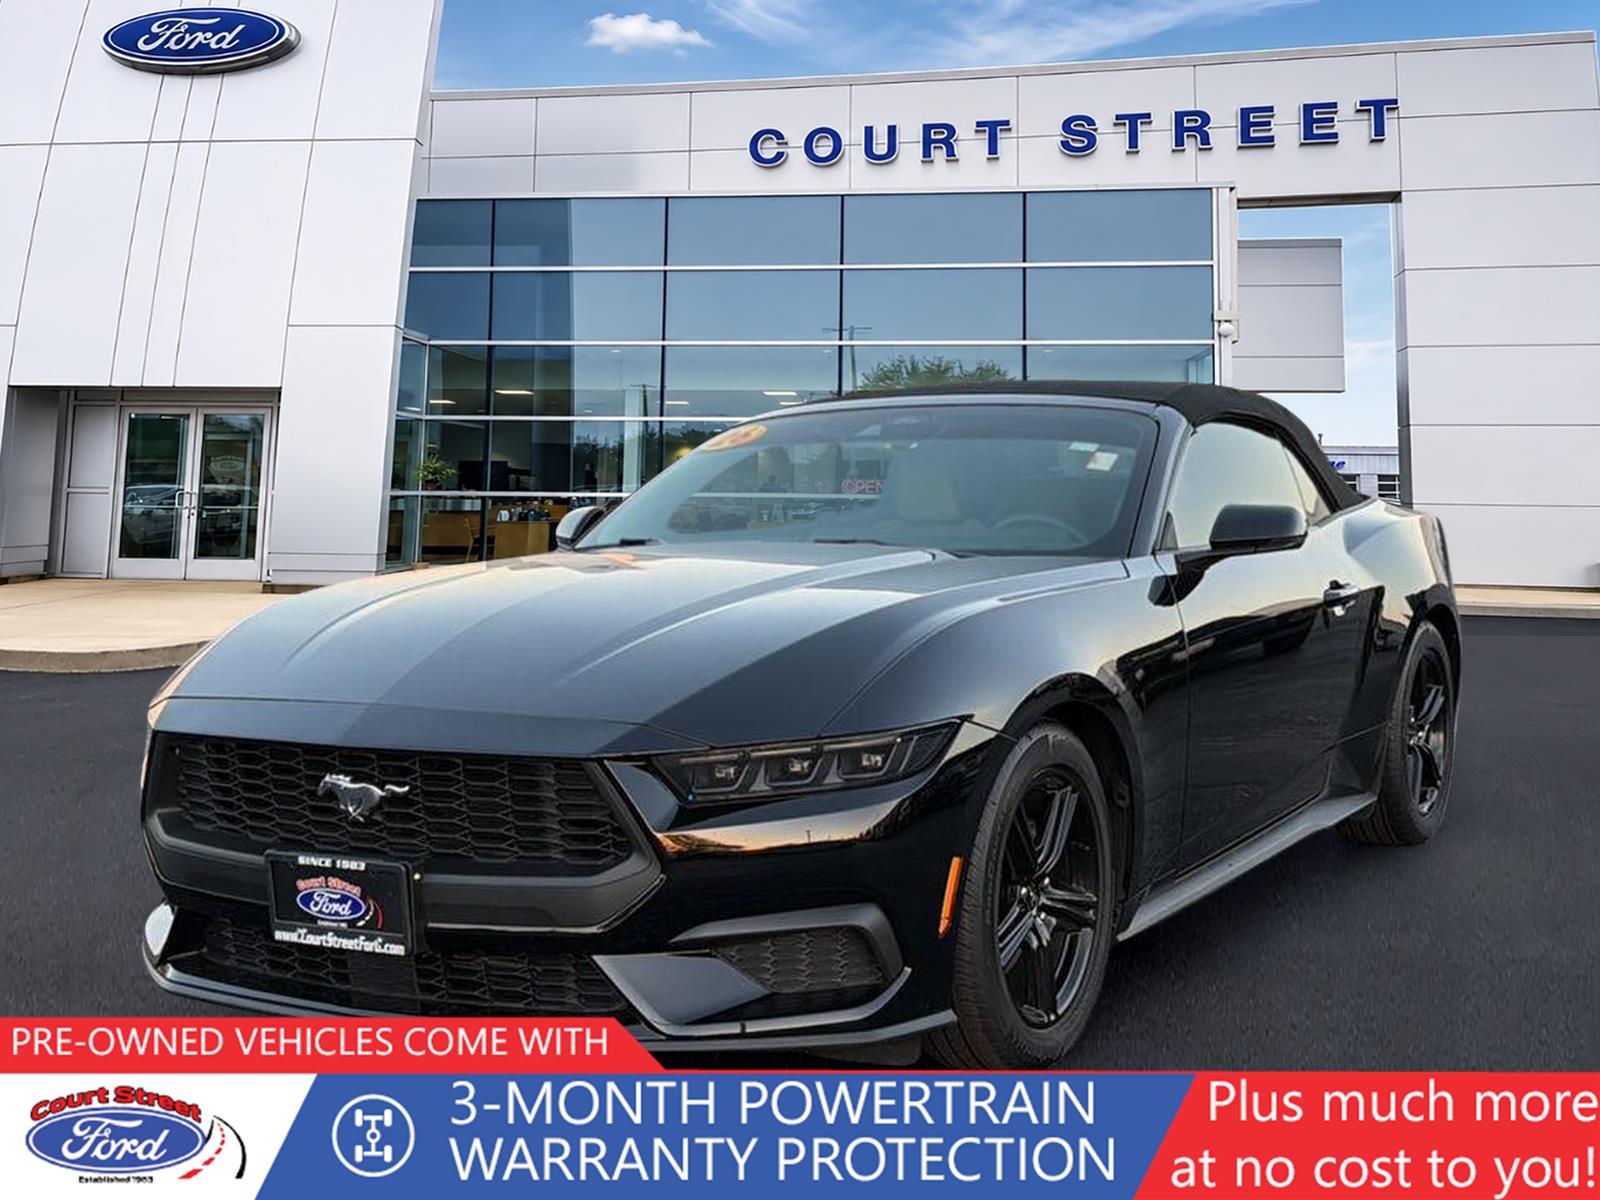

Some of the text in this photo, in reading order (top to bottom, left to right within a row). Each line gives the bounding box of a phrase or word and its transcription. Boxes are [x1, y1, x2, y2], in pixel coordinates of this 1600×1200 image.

[137, 17, 246, 51] Ford
[748, 97, 1399, 168] COURT STREET
[298, 856, 332, 867] SINCE
[310, 891, 353, 915] Ford
